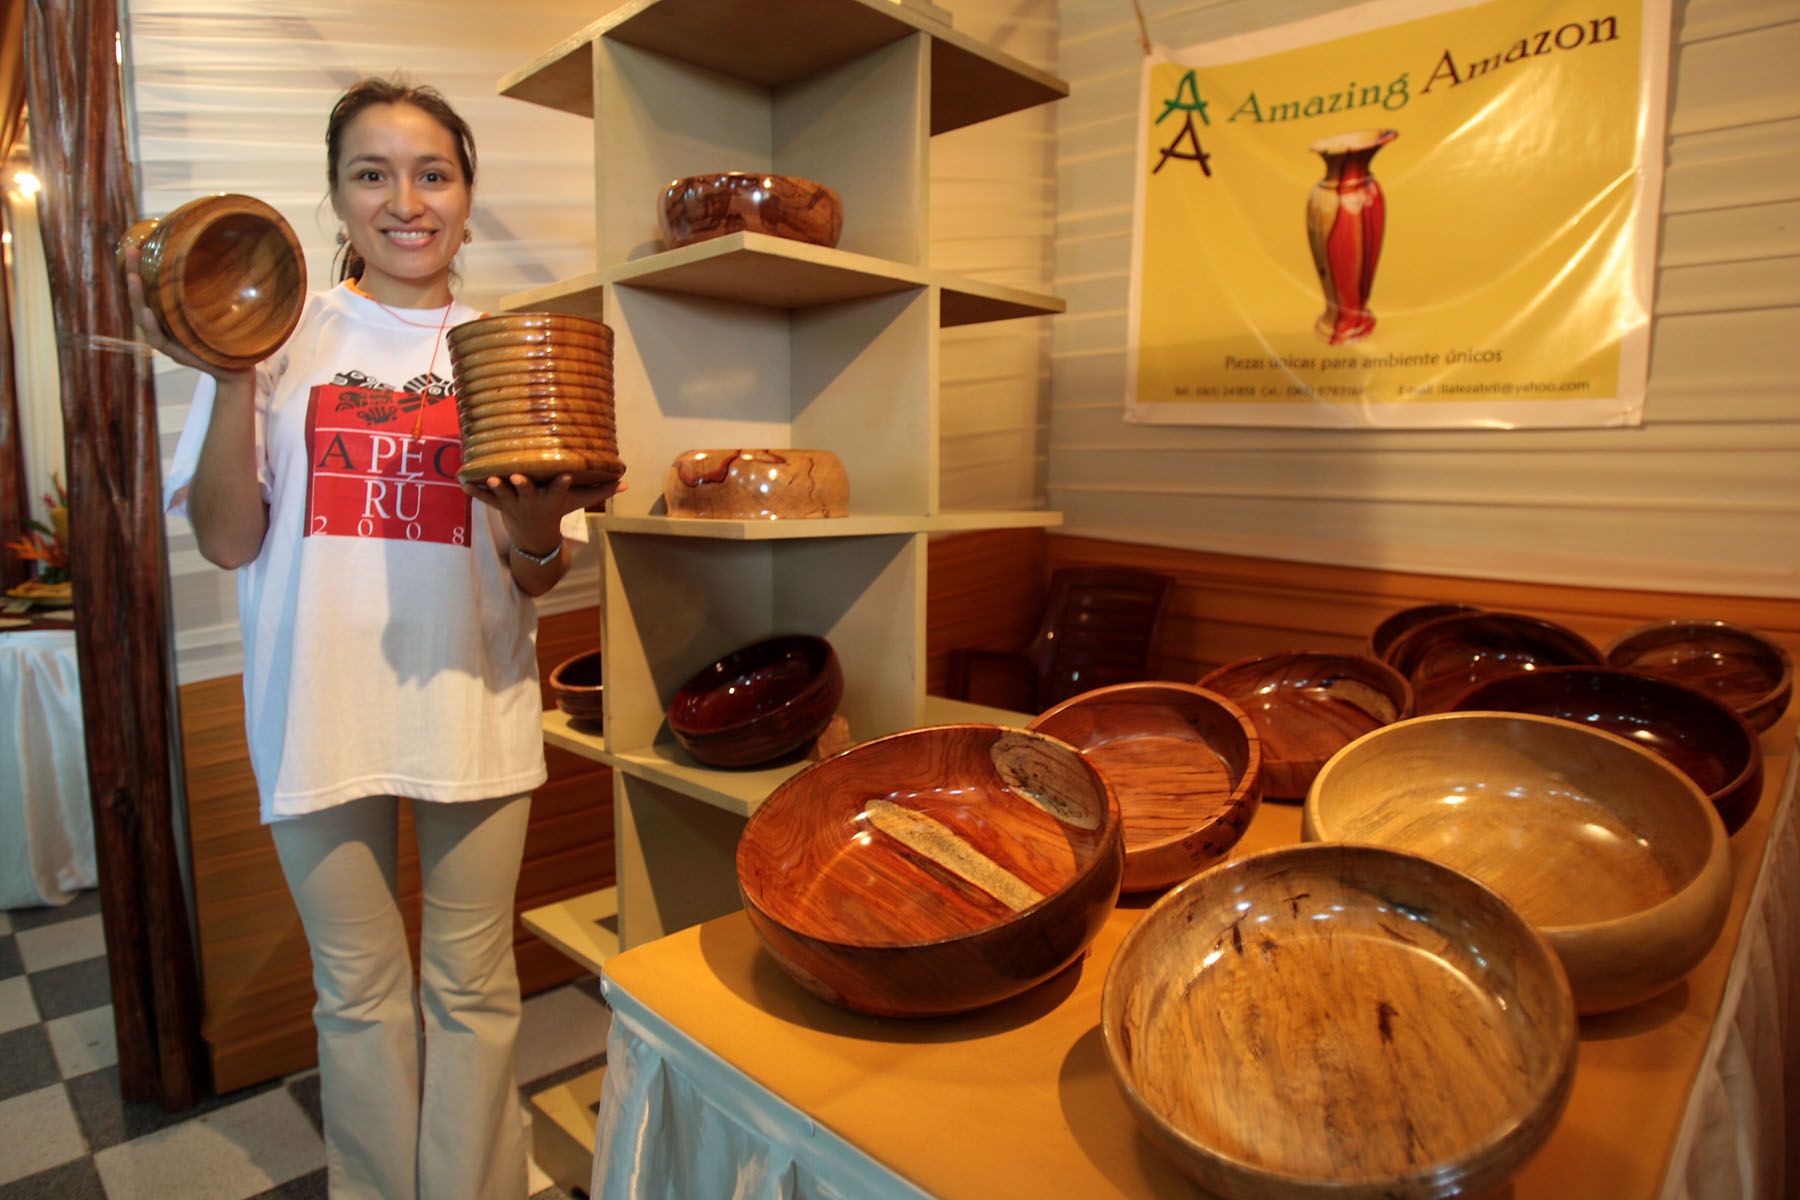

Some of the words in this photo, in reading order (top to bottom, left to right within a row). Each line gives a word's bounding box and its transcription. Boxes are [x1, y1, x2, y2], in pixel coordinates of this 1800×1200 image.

[1227, 74, 1409, 123] Amazing
[1420, 15, 1620, 95] Amazon
[1225, 355, 1264, 370] Piezas
[1320, 357, 1357, 372] para
[1362, 352, 1440, 368] ambiente
[1445, 347, 1504, 364] únicos
